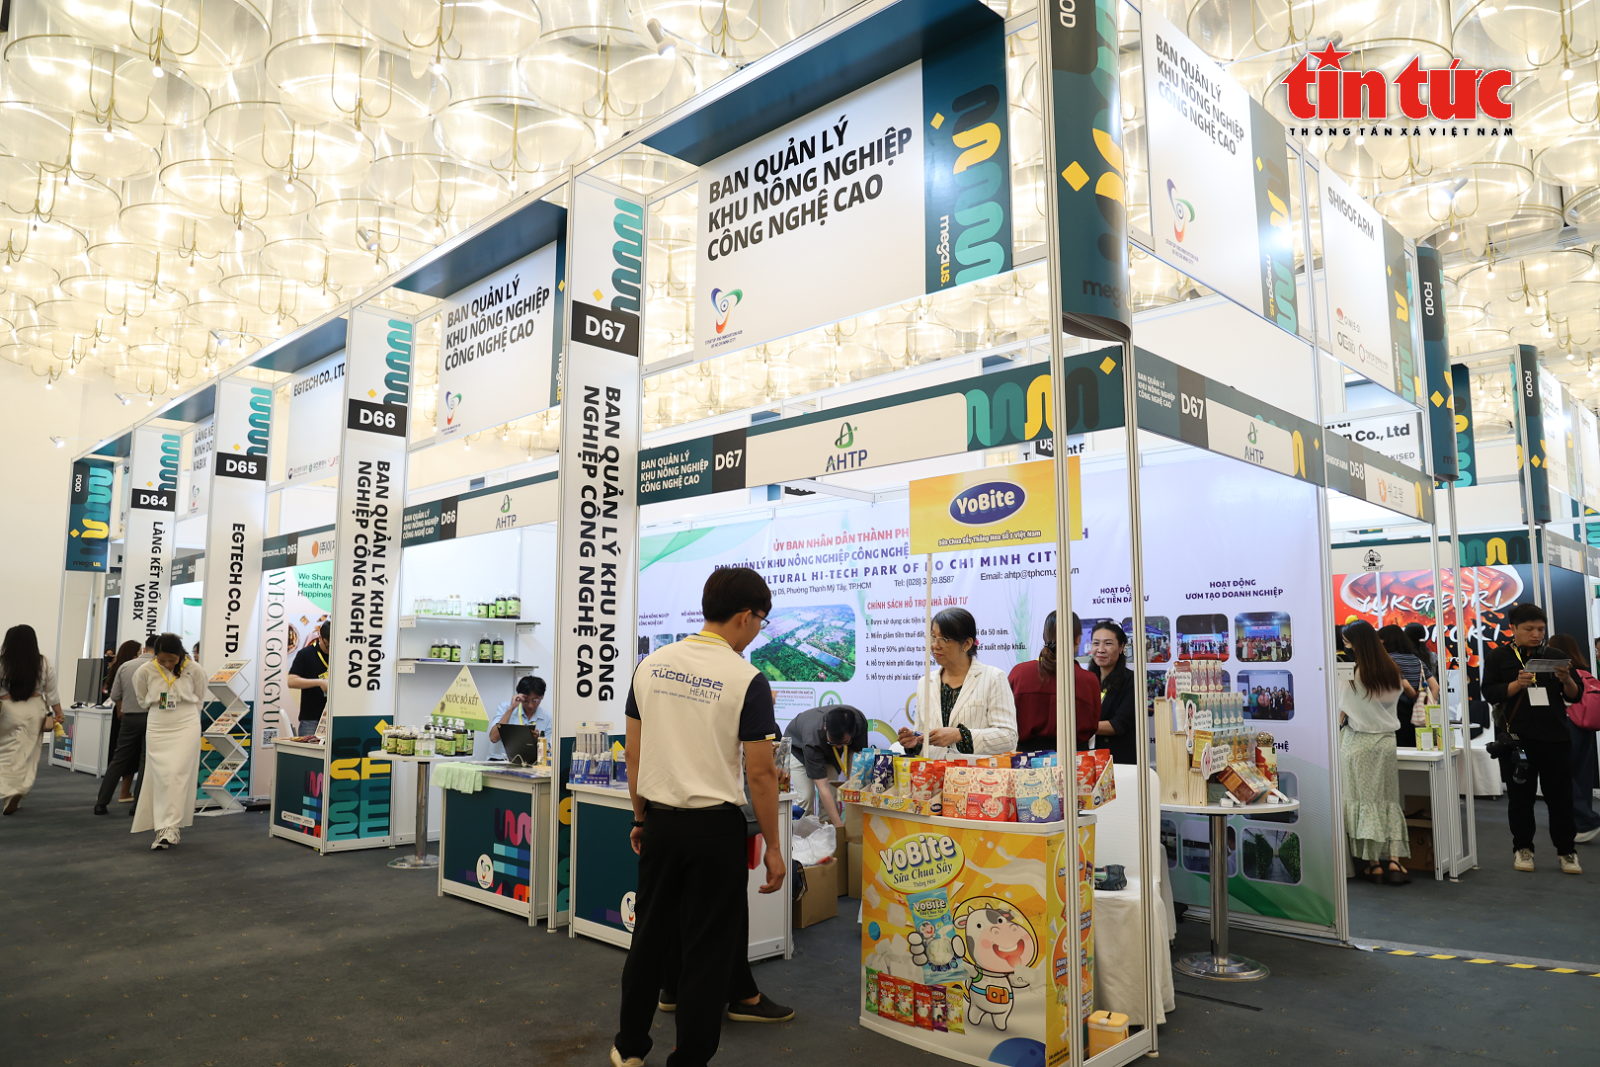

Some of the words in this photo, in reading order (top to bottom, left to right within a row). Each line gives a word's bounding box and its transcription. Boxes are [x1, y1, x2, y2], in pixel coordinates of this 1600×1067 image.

[1155, 34, 1178, 67] BAN
[1180, 57, 1209, 93] QUẢN
[1211, 79, 1222, 104] LÝ
[1156, 57, 1179, 91] KHU
[1181, 75, 1210, 113] NÔNG
[1212, 103, 1245, 143] NGHIỆP
[1157, 80, 1187, 118] CÔNG
[1189, 105, 1216, 145] NGHỆ
[1217, 129, 1236, 155] CAO
[709, 167, 749, 204] BAN
[753, 137, 816, 186] QUẢN
[822, 114, 849, 154] LÝ
[708, 197, 748, 233] KHU
[753, 168, 817, 217] NÔNG
[824, 126, 912, 185] NGHIỆP
[707, 221, 763, 261] CÔNG
[768, 189, 828, 240] NGHỆ
[833, 173, 883, 212] CAO
[1327, 186, 1375, 241] SHIGOFARM
[447, 301, 470, 328] BAN
[472, 285, 503, 320] QUẢN
[504, 274, 520, 304] LÝ
[1423, 281, 1434, 316] FOOD
[446, 324, 469, 350] KHU
[470, 309, 504, 342] NÔNG
[505, 286, 550, 325] NGHIỆP
[584, 315, 625, 342] D67
[445, 345, 475, 373] CÔNG
[476, 327, 507, 362] NGHỆ
[509, 319, 534, 349] CAO
[293, 374, 319, 396] EGTECH
[318, 369, 333, 385] CO.,
[1525, 370, 1533, 398] FOOD
[359, 408, 396, 429] D66
[604, 384, 621, 439] BAN
[1180, 392, 1204, 420] D67
[578, 385, 601, 479] NGHIỆP
[1355, 430, 1384, 442] Co.,
[1386, 423, 1410, 438] Ltd
[225, 459, 258, 475] D65
[640, 470, 656, 482] KHU
[657, 465, 679, 479] NÔNG
[680, 458, 709, 474] NGHIỆP
[641, 458, 656, 470] BAN
[657, 452, 679, 468] QUẢN
[680, 449, 690, 463] LÝ
[714, 449, 743, 471] D67
[825, 449, 868, 472] AHTP
[1244, 446, 1264, 465] AHTP
[1349, 460, 1364, 480] D58
[74, 474, 82, 493] FOOD
[352, 460, 372, 529] NGHIỆP
[376, 459, 390, 500] BAN
[599, 445, 624, 520] QUẢN
[640, 481, 661, 493] CÔNG
[662, 475, 683, 490] NGHỆ
[684, 474, 700, 486] CAO
[139, 494, 168, 507] D64
[956, 488, 1015, 515] YoBite
[371, 503, 391, 558] QUẢN
[440, 509, 456, 526] D66
[495, 514, 517, 529] AHTP
[580, 484, 601, 559] CÔNG
[151, 521, 165, 554] LÀNG
[229, 523, 246, 584] EGTECH
[287, 543, 297, 555] D65
[601, 527, 621, 557] LÝ
[773, 538, 785, 552] ỦY
[786, 538, 805, 550] BAN
[806, 534, 834, 549] NHÂN
[835, 531, 856, 546] DÂN
[857, 527, 893, 543] THÀNH
[948, 536, 962, 546] Chua
[1013, 531, 1026, 540] Việt
[1027, 530, 1041, 538] Nam
[150, 557, 164, 578] KẾT
[352, 533, 371, 587] CÔNG
[756, 556, 766, 570] LÝ
[767, 558, 786, 568] KHU
[788, 553, 814, 567] NÔNG
[815, 548, 850, 565] NGHIỆP
[851, 546, 879, 563] CÔNG
[881, 542, 909, 560] NGHỆ
[811, 567, 858, 581] HI-TECH
[864, 564, 898, 577] PARK
[903, 562, 920, 574] OF
[950, 558, 974, 570] CHI
[980, 553, 1021, 567] MINH
[371, 563, 388, 586] LÝ
[600, 562, 617, 616] KHU
[1209, 579, 1231, 589] HOẠT
[1232, 577, 1256, 588] ĐỘNG
[133, 583, 145, 621] VABIX
[148, 581, 163, 603] NỐI
[224, 587, 241, 621] CO.,
[573, 565, 598, 637] NGHỆ
[867, 600, 886, 610] CHÍNH
[887, 599, 903, 610] SÁCH
[904, 596, 913, 608] HỖ
[914, 598, 927, 609] TRỢ
[944, 595, 958, 606] ĐẦU
[959, 596, 968, 605] TƯ
[1185, 592, 1204, 600] ƯƠM
[1204, 592, 1221, 601] TẠO
[1221, 589, 1252, 599] DOANH
[1253, 587, 1284, 599] NGHIỆP
[146, 606, 158, 639] KINH
[345, 592, 367, 645] NGHỆ
[369, 590, 384, 629] KHU
[224, 622, 240, 658] LTD.
[347, 649, 363, 689] CAO
[367, 634, 386, 691] NÔNG
[576, 644, 593, 699] CAO
[598, 623, 619, 702] NÔNG
[262, 637, 283, 729] GONGYU
[689, 687, 721, 701] HEALTH
[879, 835, 957, 874] YoBite
[911, 868, 934, 880] Chua
[936, 859, 953, 874] Sấy
[913, 898, 946, 912] YoBite
